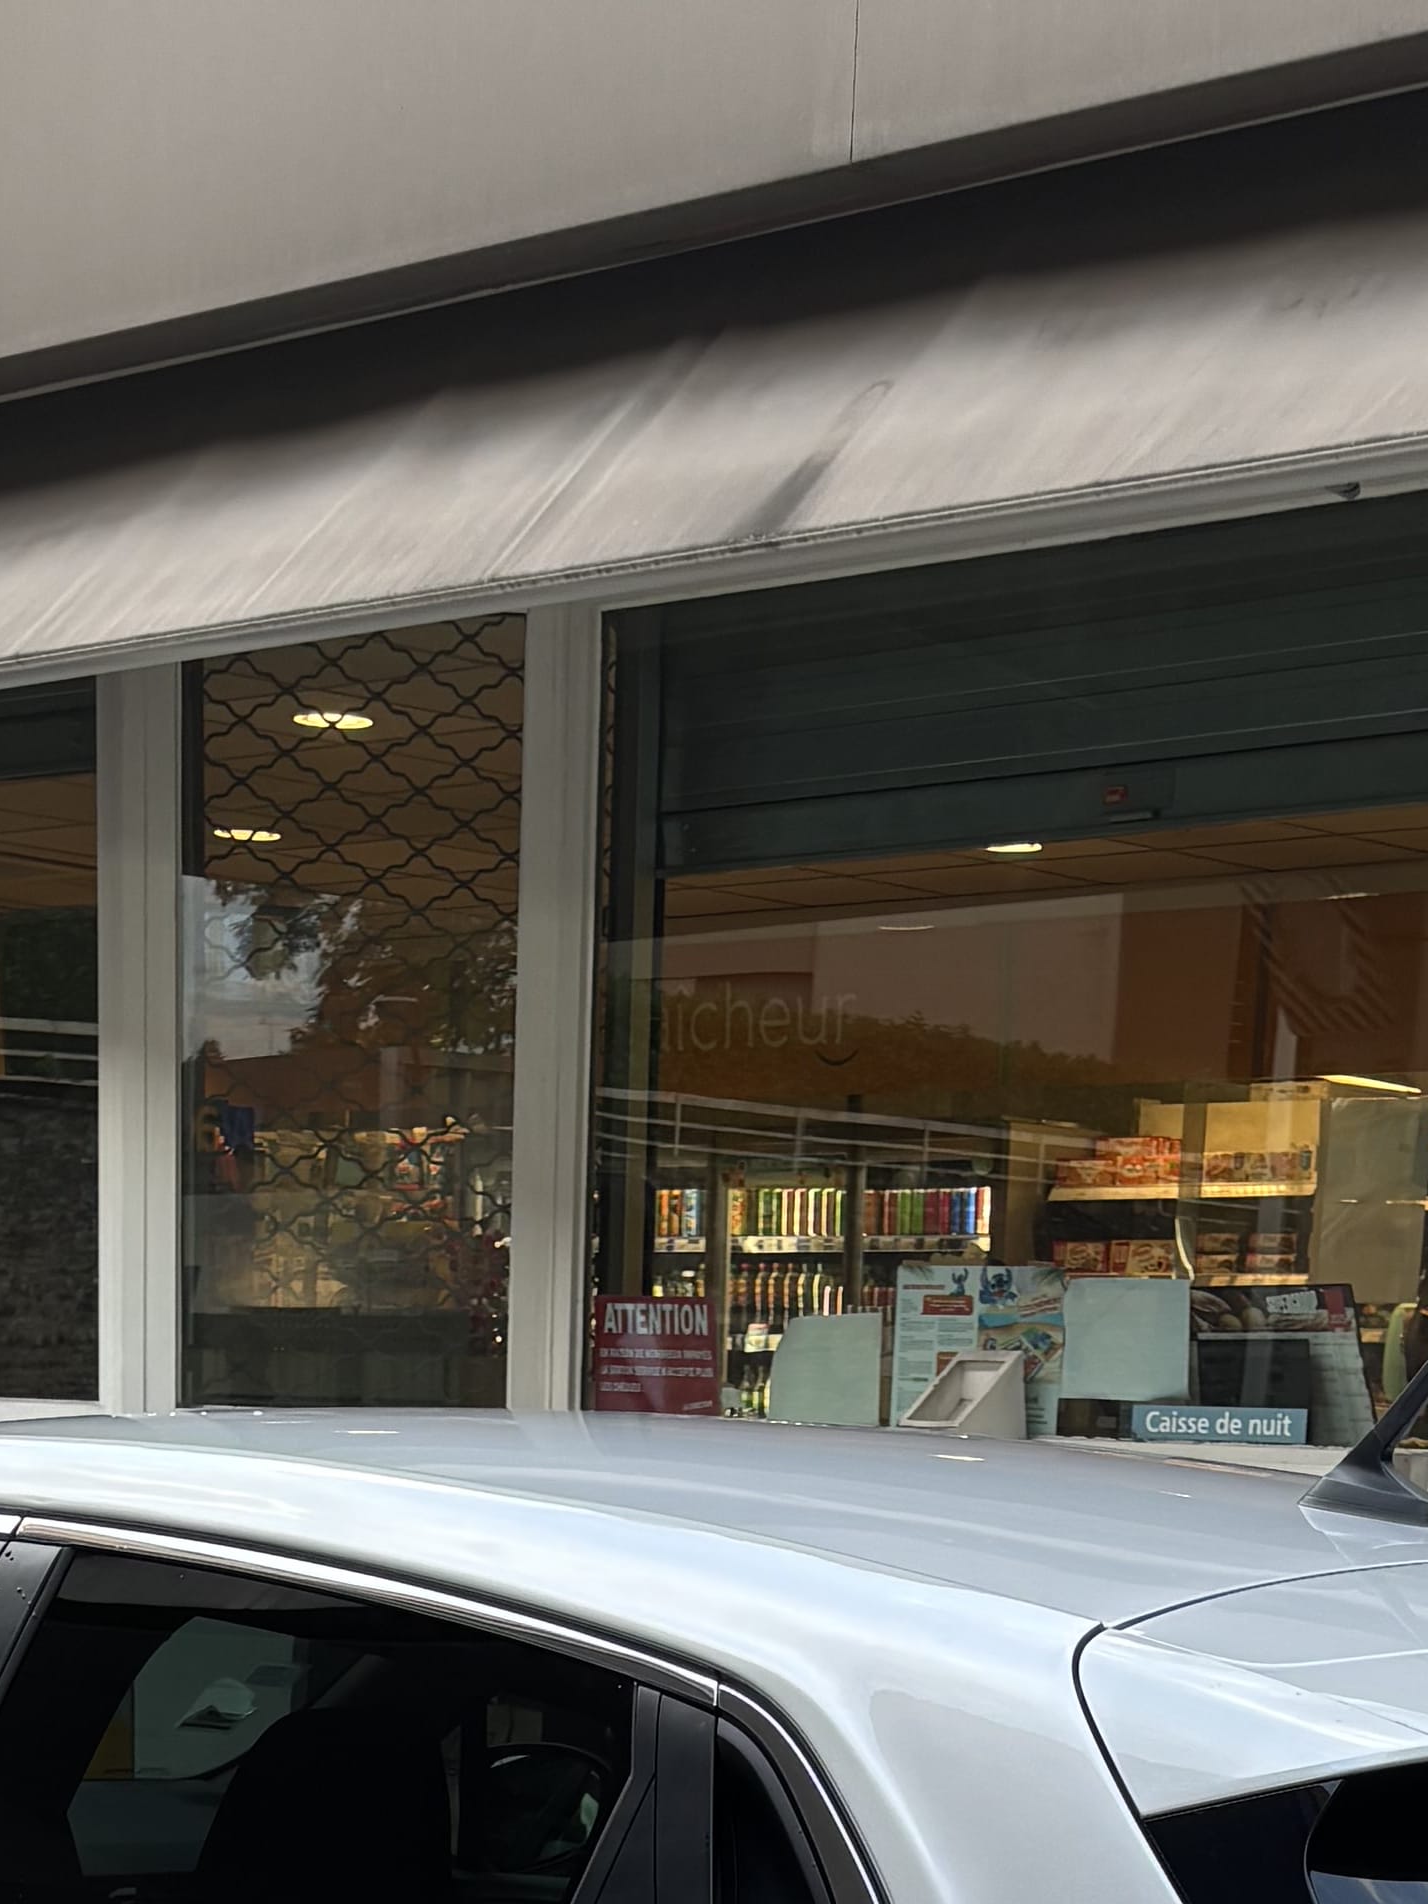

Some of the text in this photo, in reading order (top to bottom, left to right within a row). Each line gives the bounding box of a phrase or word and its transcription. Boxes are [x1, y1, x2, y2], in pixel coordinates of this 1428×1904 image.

[604, 1302, 709, 1336] ATTENTION
[1145, 1410, 1293, 1437] Caisse de nuit
